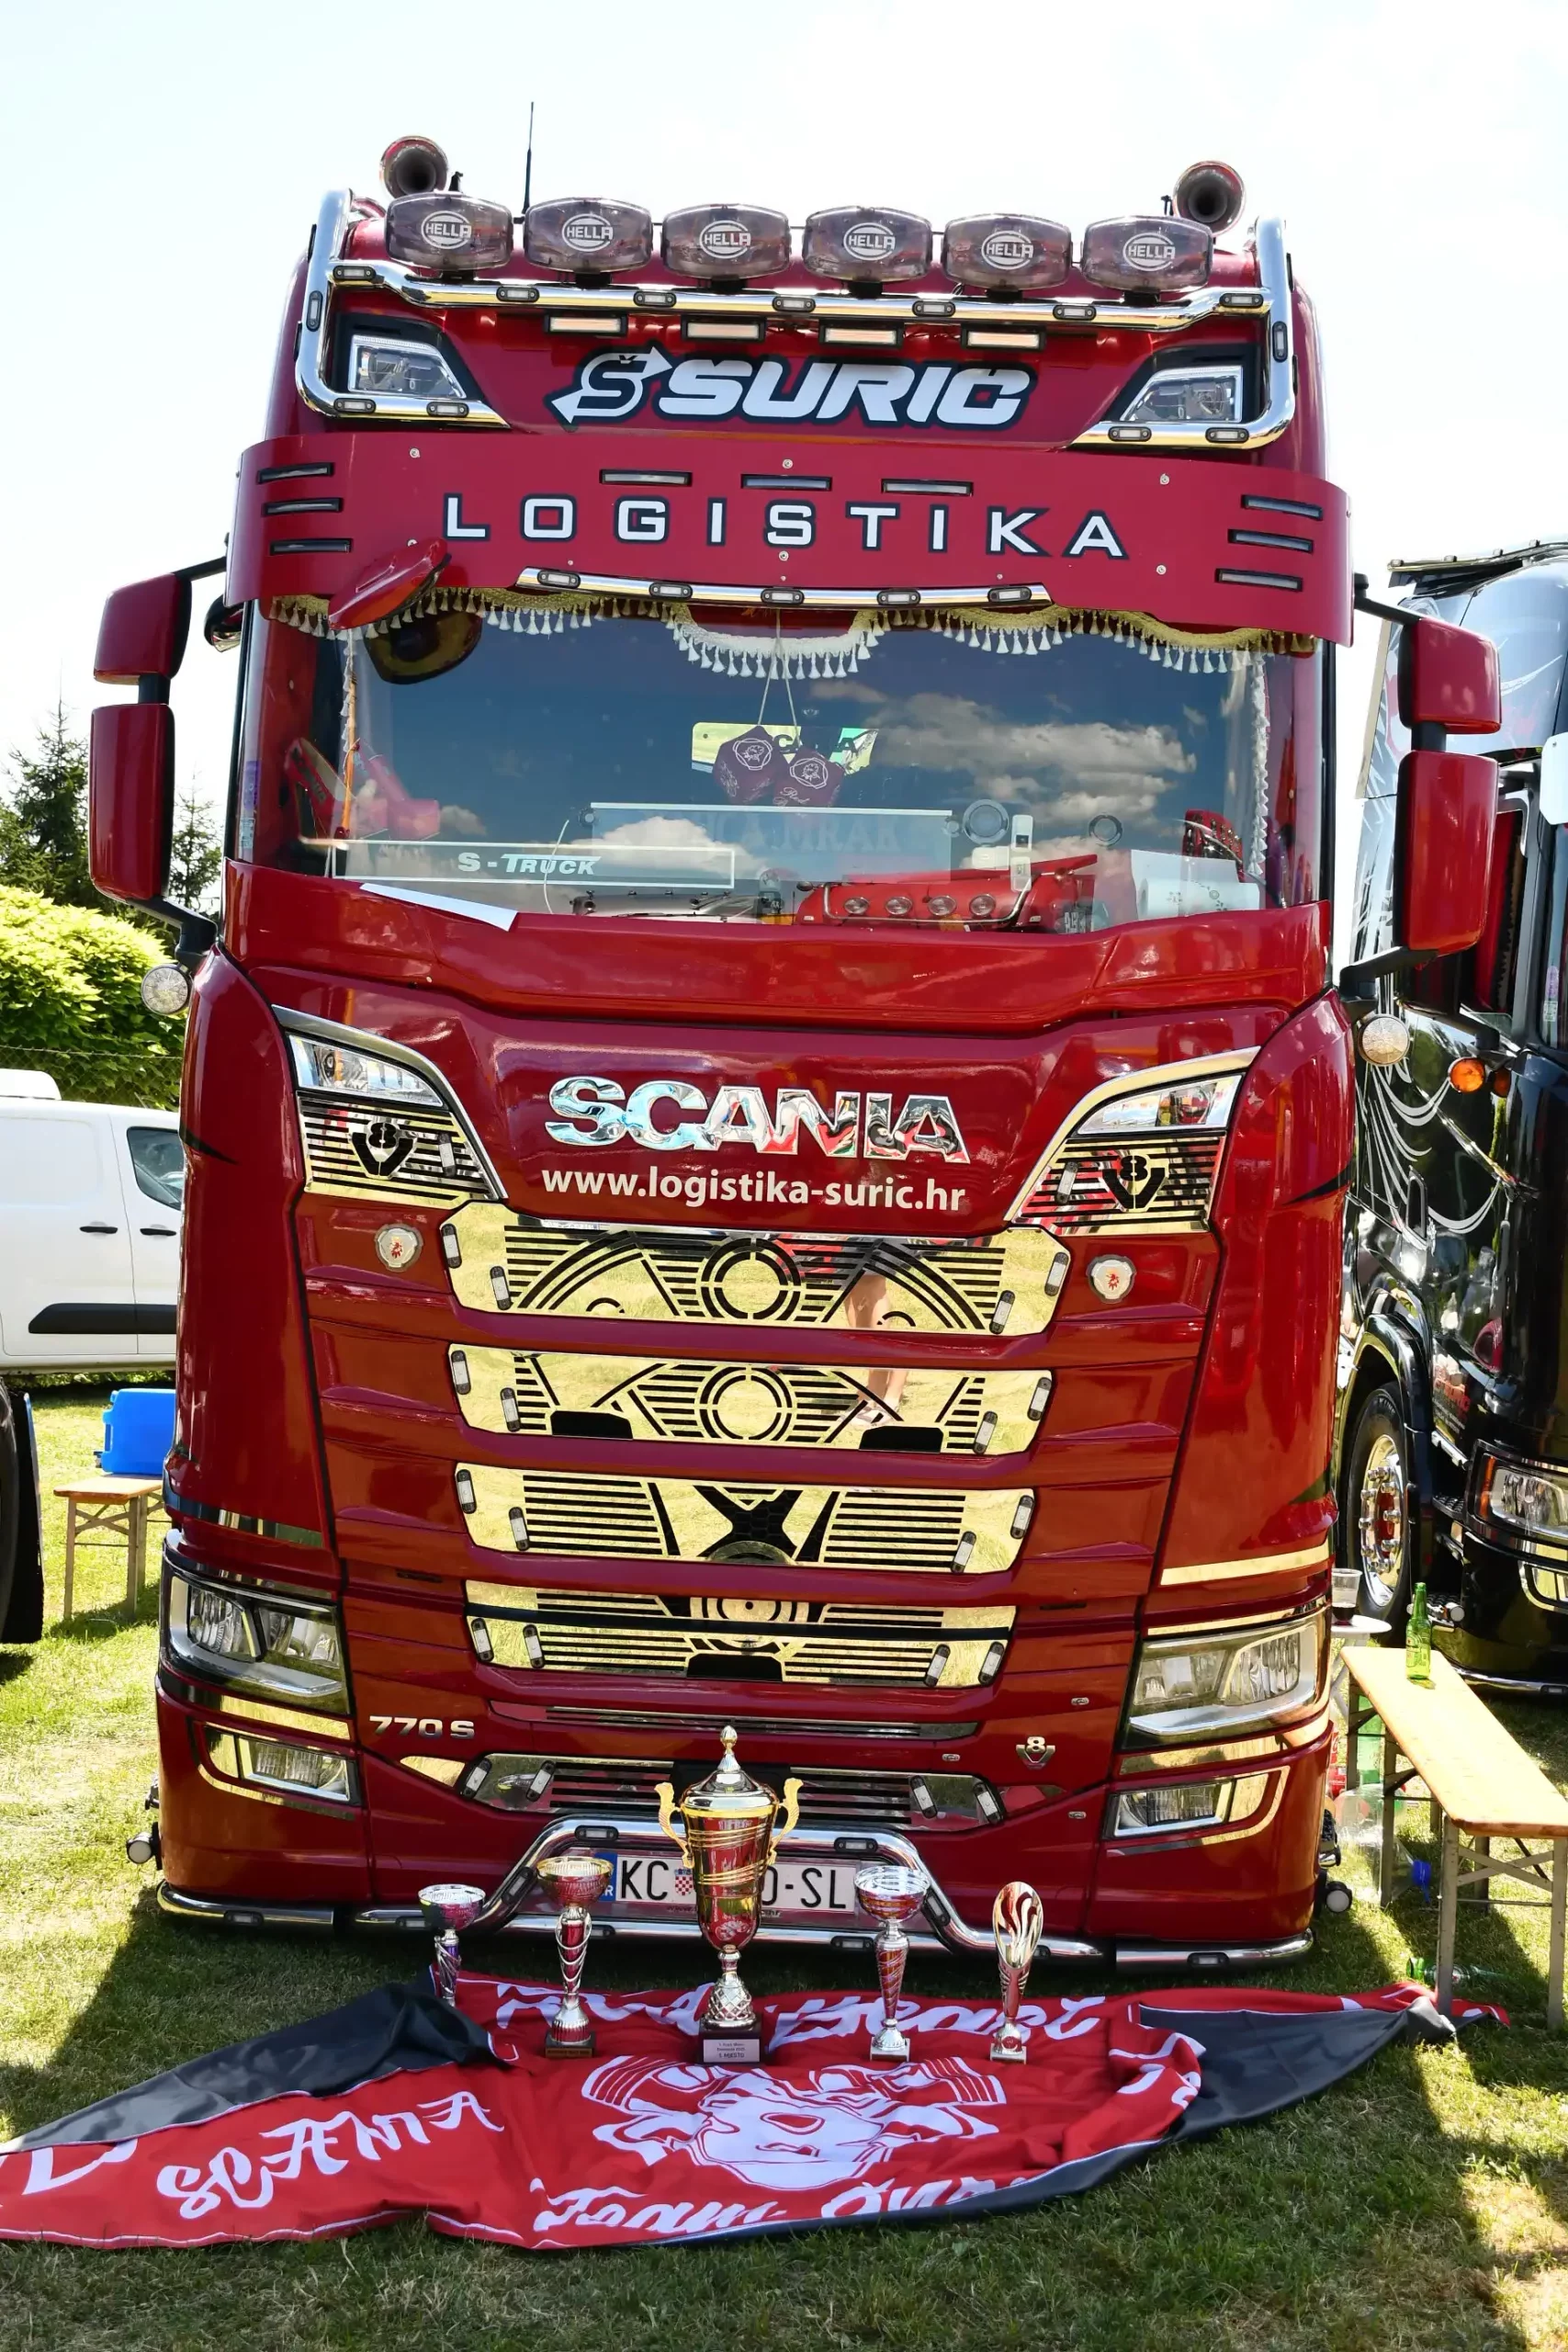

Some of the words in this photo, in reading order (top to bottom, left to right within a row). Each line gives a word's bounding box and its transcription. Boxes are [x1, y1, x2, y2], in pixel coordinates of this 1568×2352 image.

[424, 222, 472, 238] HELLA
[566, 225, 614, 241] HELLA
[704, 232, 752, 246] HELLA
[848, 235, 896, 249] HELLA
[986, 243, 1034, 258] HELLA
[1127, 245, 1176, 259] HELLA
[444, 495, 1126, 559] LOGISTIKA
[545, 1076, 971, 1165] SCANIA
[541, 1166, 965, 1211] www.logistika-suric.hr
[369, 1715, 443, 1738] 770
[450, 1720, 475, 1739] S
[622, 1860, 669, 1901] KC
[761, 1864, 847, 1909] 0-SL
